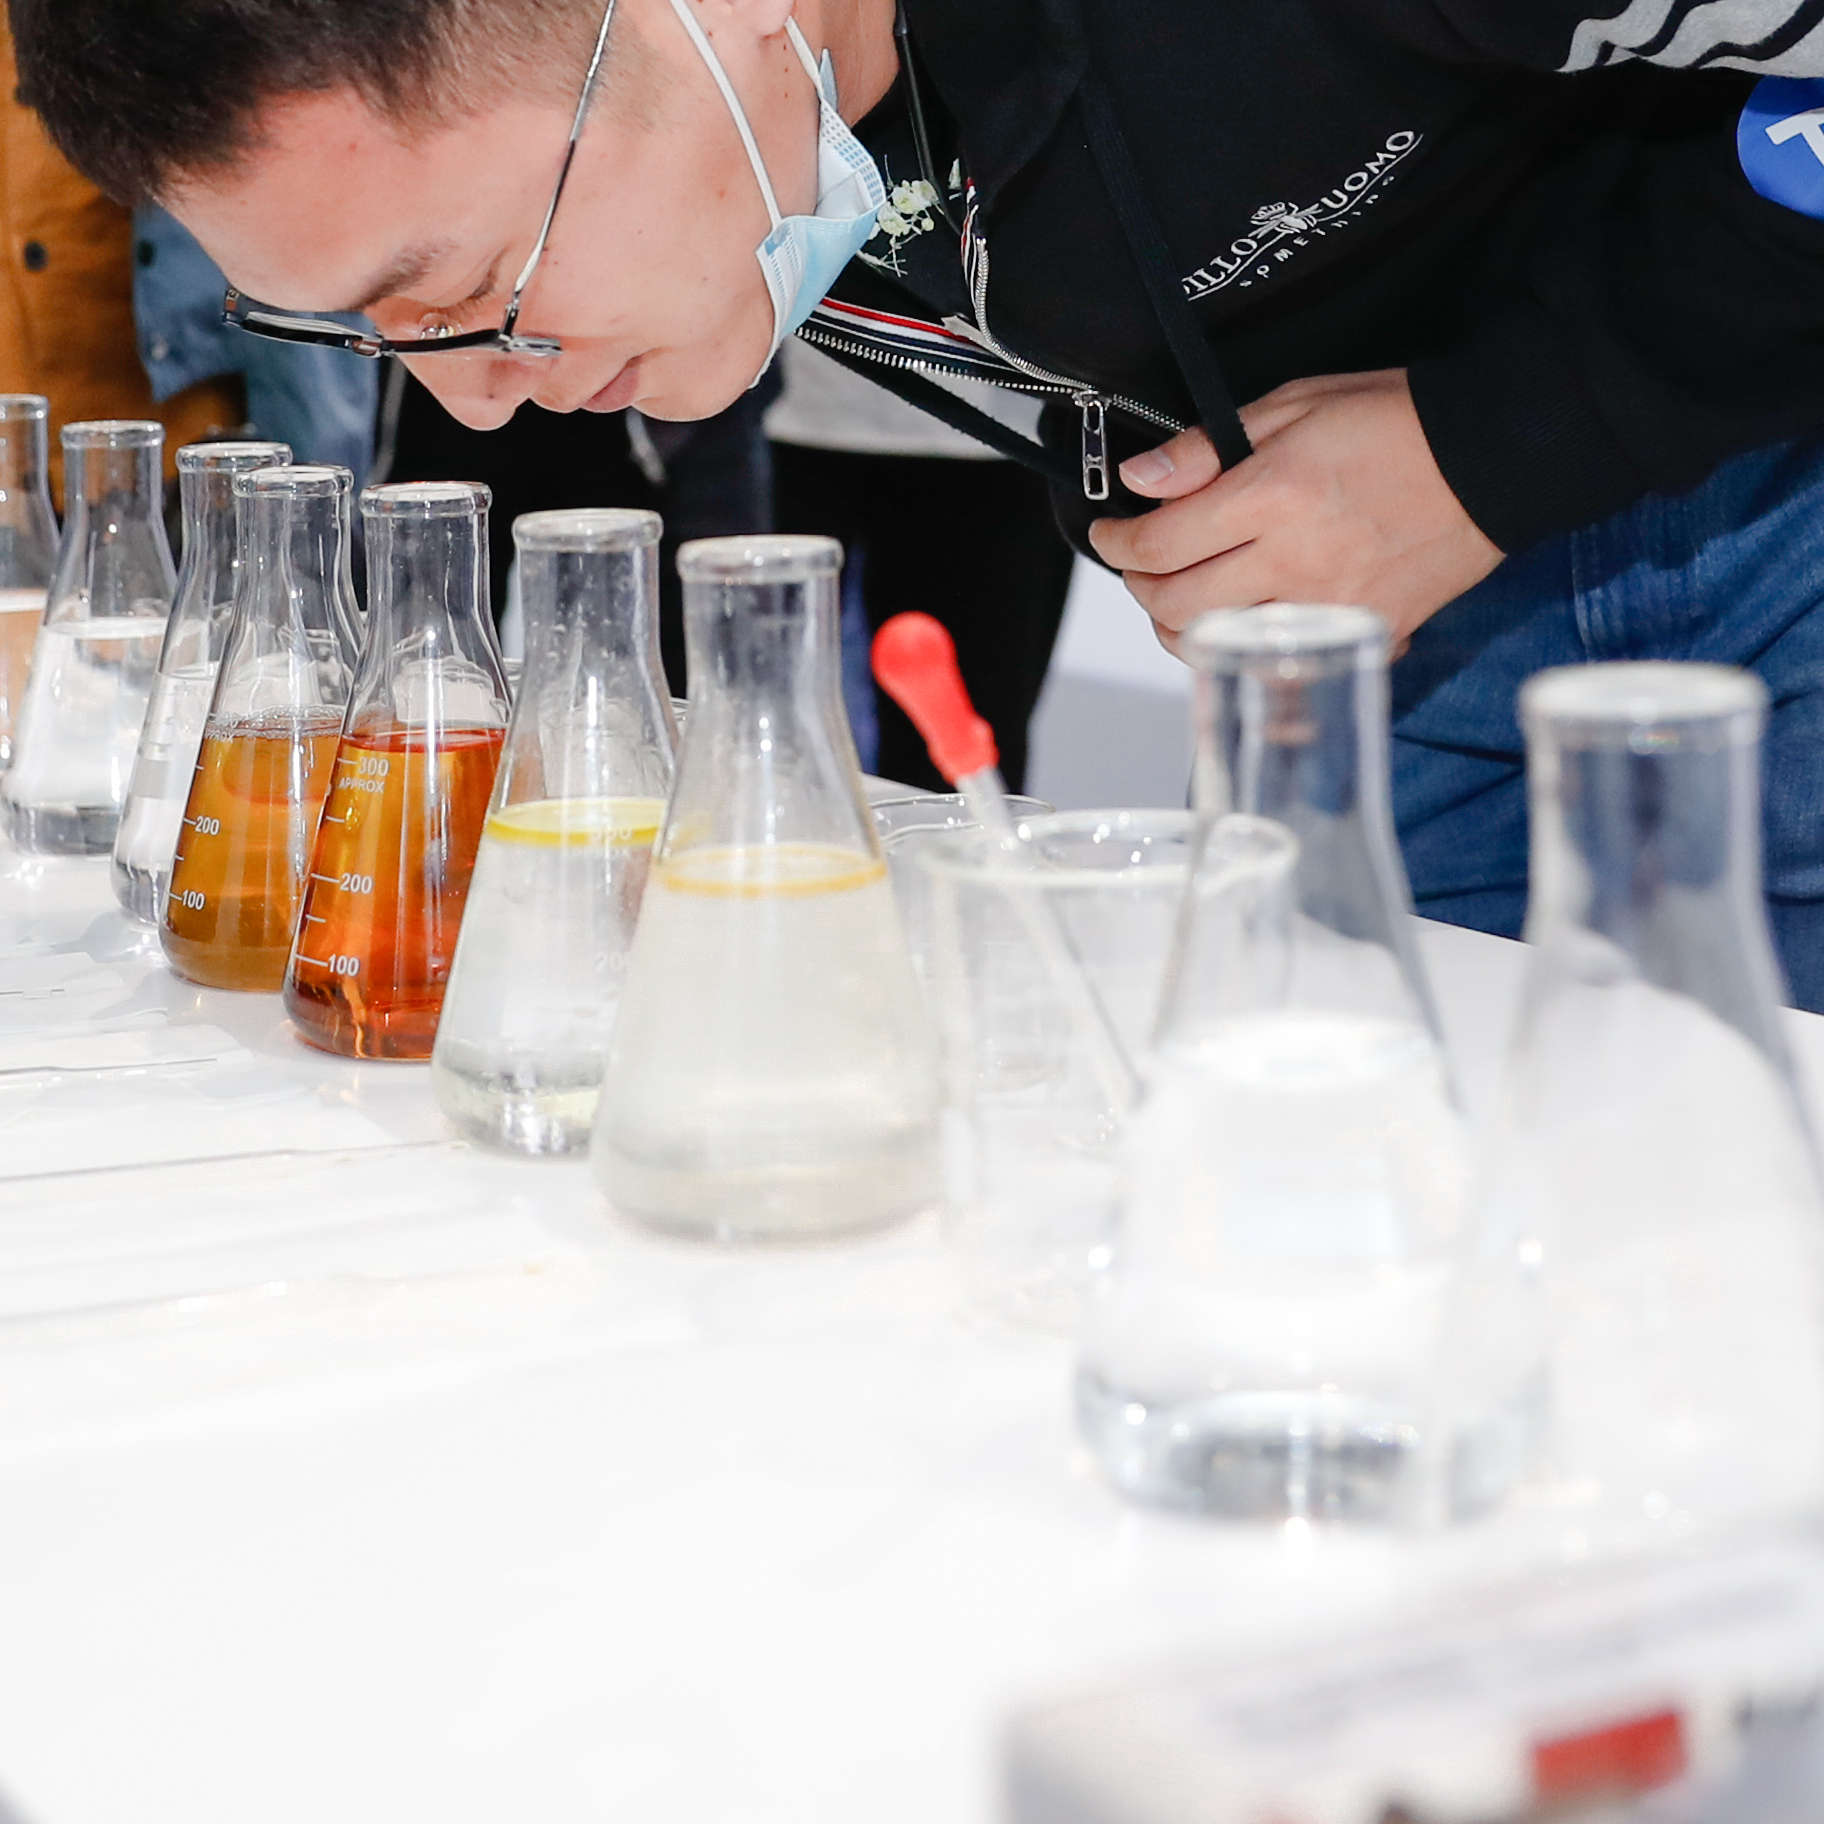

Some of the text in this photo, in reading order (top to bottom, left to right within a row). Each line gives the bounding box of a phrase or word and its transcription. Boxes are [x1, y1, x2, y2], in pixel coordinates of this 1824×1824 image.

[1320, 130, 1415, 209] UOMO
[357, 757, 389, 777] 300
[338, 778, 385, 794] APPROX
[194, 815, 220, 836] 200
[339, 873, 373, 895] 200
[181, 889, 205, 911] 100
[327, 955, 360, 977] 100
